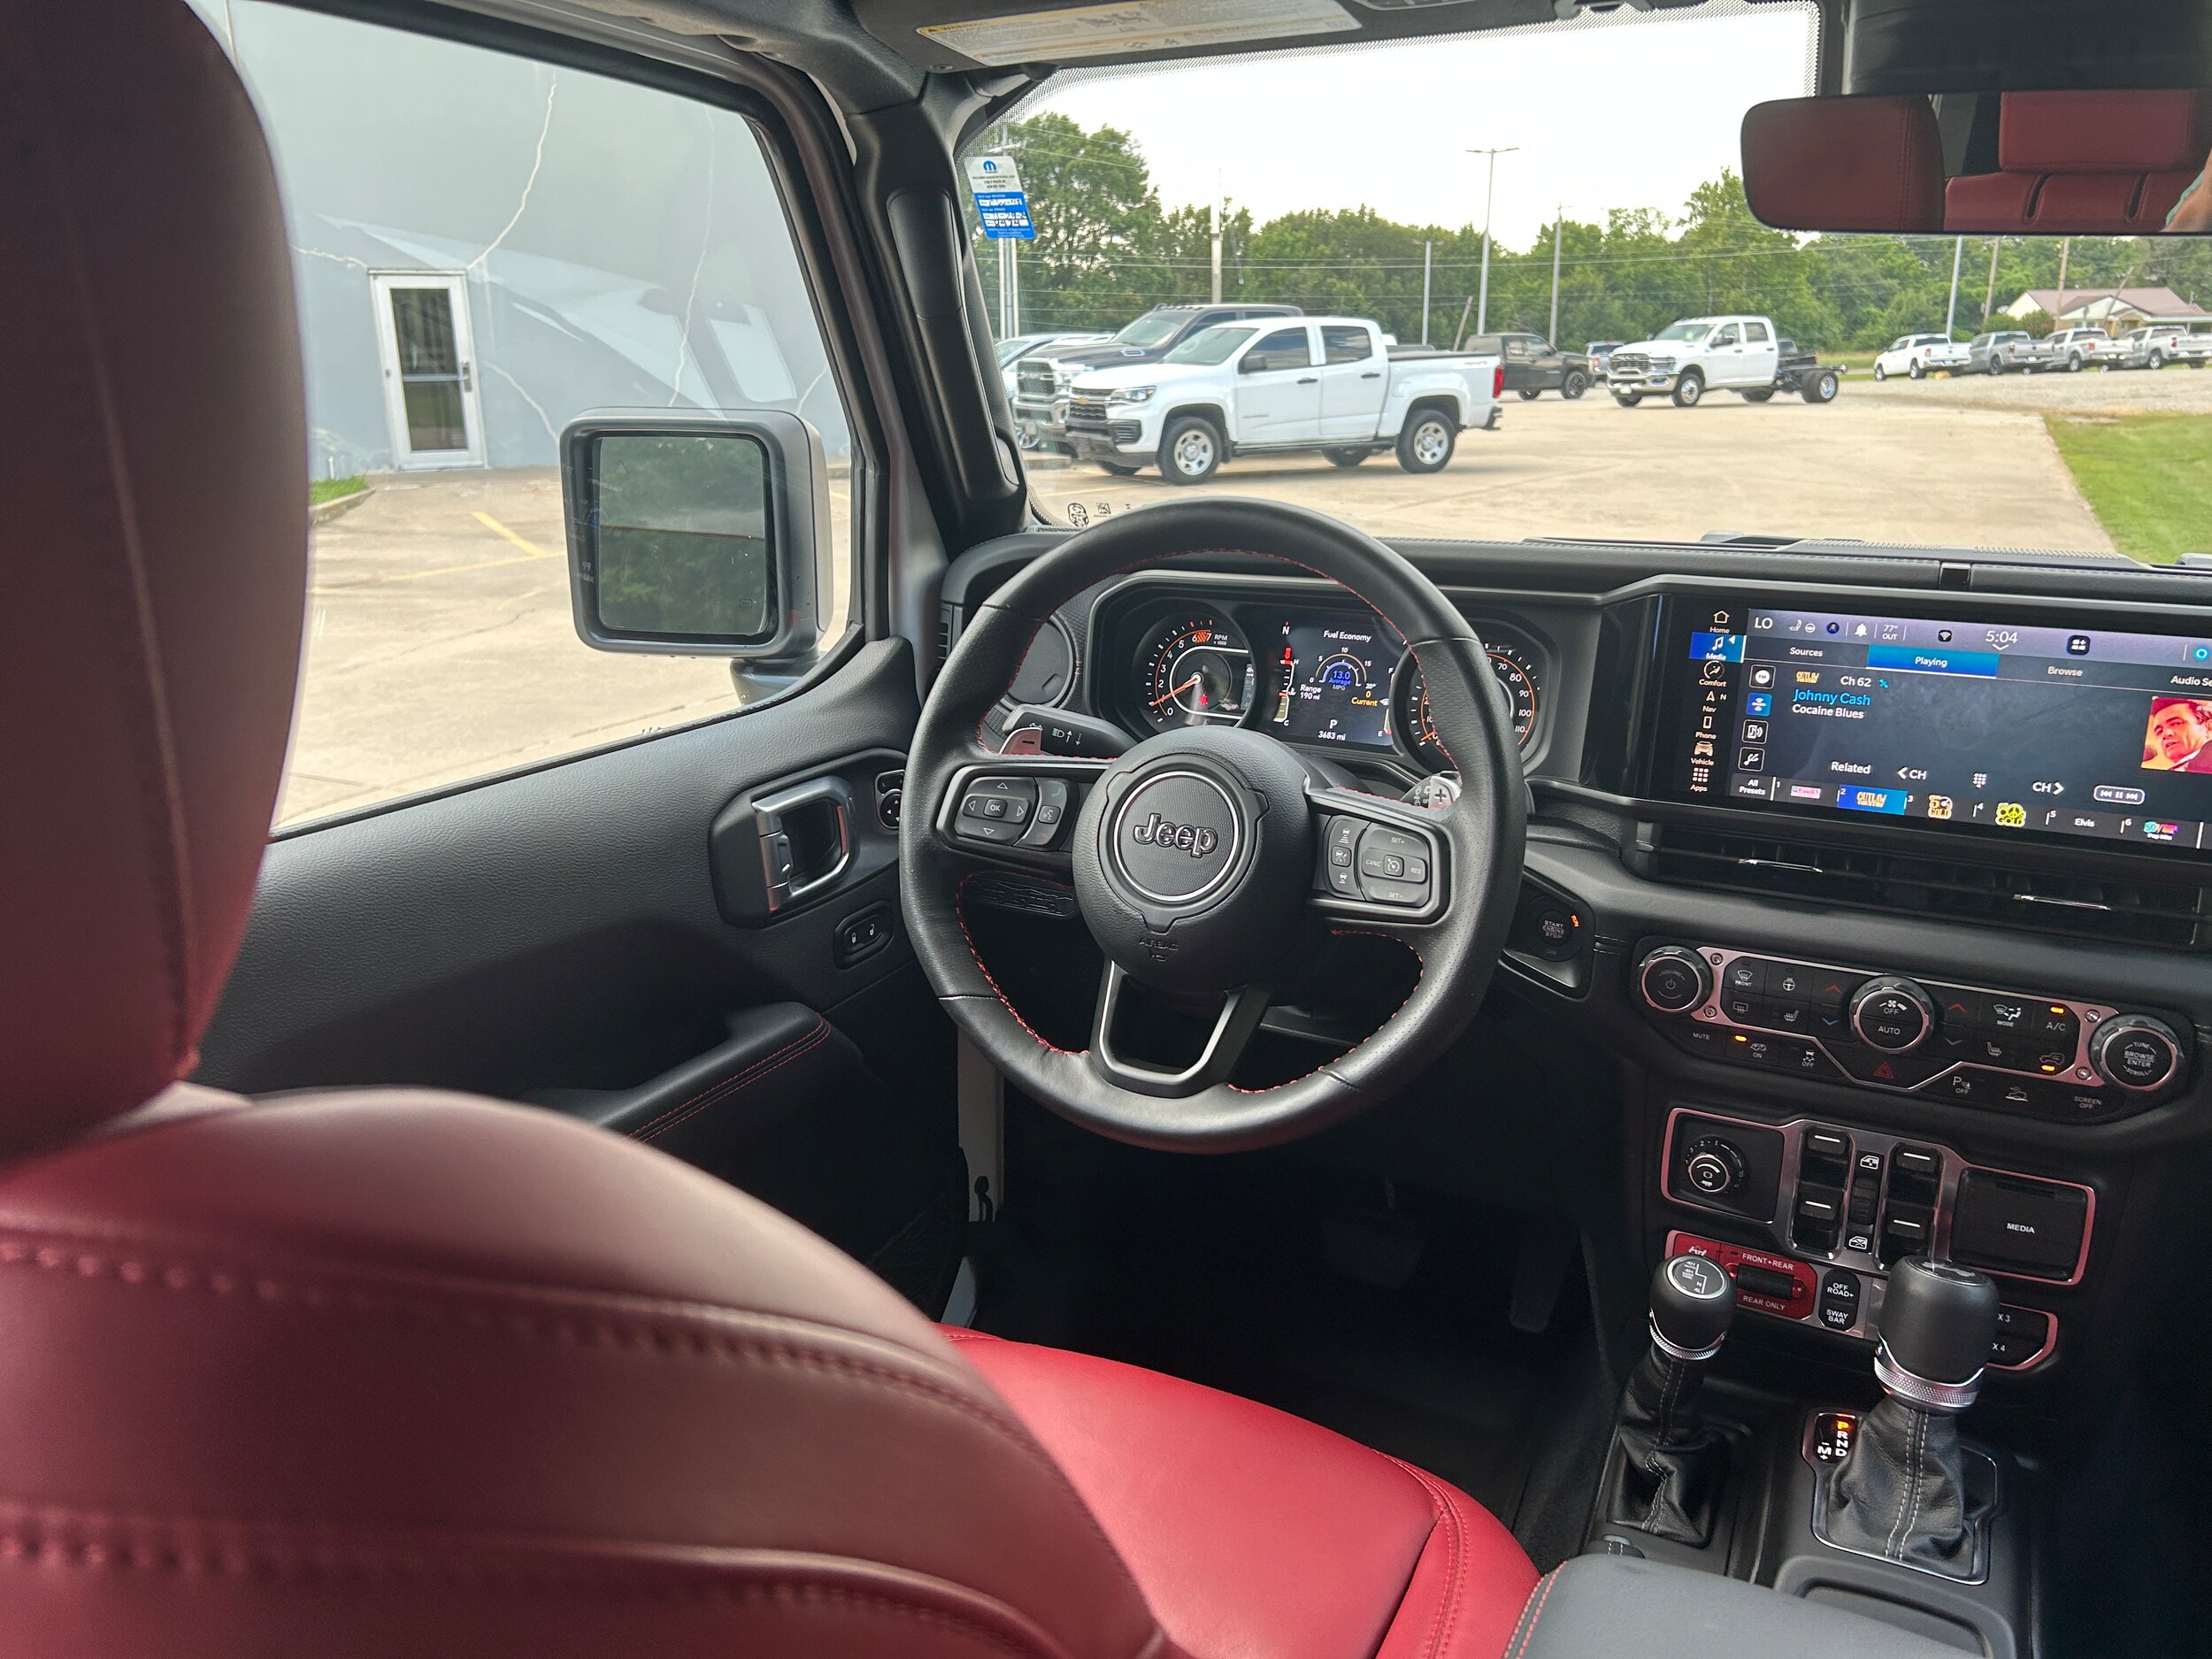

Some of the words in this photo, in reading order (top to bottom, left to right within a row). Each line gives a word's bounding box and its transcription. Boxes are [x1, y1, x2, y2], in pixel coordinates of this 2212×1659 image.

[1755, 618, 1773, 630] LO
[1282, 626, 1290, 635] N
[1192, 634, 1198, 642] 6
[1324, 630, 1339, 639] Fuel
[1340, 632, 1371, 643] Economy
[1985, 630, 2018, 643] 5:04
[1179, 640, 1185, 649] 5
[1789, 647, 1824, 657] Sources
[1915, 657, 1947, 668] Playing
[1160, 664, 1166, 673] 3
[2047, 666, 2083, 677] Browse
[1333, 671, 1351, 680] 13.0
[1509, 673, 1522, 682] 80
[1158, 680, 1164, 688] 2
[1328, 677, 1351, 687] Average
[1699, 679, 1727, 687] Comfort
[1840, 676, 1855, 686] Ch
[1857, 678, 1871, 687] 62
[2170, 675, 2200, 687] Audio
[1300, 684, 1322, 694] Range
[1351, 696, 1379, 707] Current
[1793, 689, 1838, 705] Johnny
[1839, 693, 1870, 706] Cash
[1792, 704, 1833, 717] Cocaine
[1835, 708, 1864, 719] Blues
[1329, 719, 1338, 729] P
[1317, 731, 1336, 740] 3683
[1695, 731, 1717, 740] Phone
[1691, 757, 1715, 766] Vehicle
[1831, 762, 1871, 775] Related
[1909, 770, 1927, 780] CH
[1690, 784, 1708, 794] Apps
[1739, 787, 1766, 796] Presets
[2032, 782, 2051, 794] CH
[2074, 818, 2095, 827] Elvis
[1133, 813, 1218, 858] Jeep
[1139, 937, 1179, 951] AIRBAG
[1883, 1007, 1900, 1016] OFF
[1878, 1025, 1901, 1035] AUTO
[2046, 1022, 2066, 1032] A/C
[1693, 1032, 1710, 1041] MUTE
[2124, 1050, 2155, 1061] BROWSE
[2127, 1058, 2151, 1068] ENTER
[2073, 1095, 2102, 1106] SCREEN
[2007, 1222, 2035, 1234] MEDIA
[1832, 1282, 1848, 1291] OFF
[1743, 1294, 1764, 1307] REAR
[1765, 1299, 1786, 1311] ONLY
[1826, 1309, 1848, 1319] SWAY
[2004, 1314, 2011, 1323] 3
[1828, 1315, 1846, 1325] BAR
[1838, 1421, 1848, 1430] P
[1838, 1431, 1848, 1440] R
[1837, 1439, 1848, 1448] N
[1817, 1446, 1832, 1455] M
[1835, 1448, 1847, 1456] D
